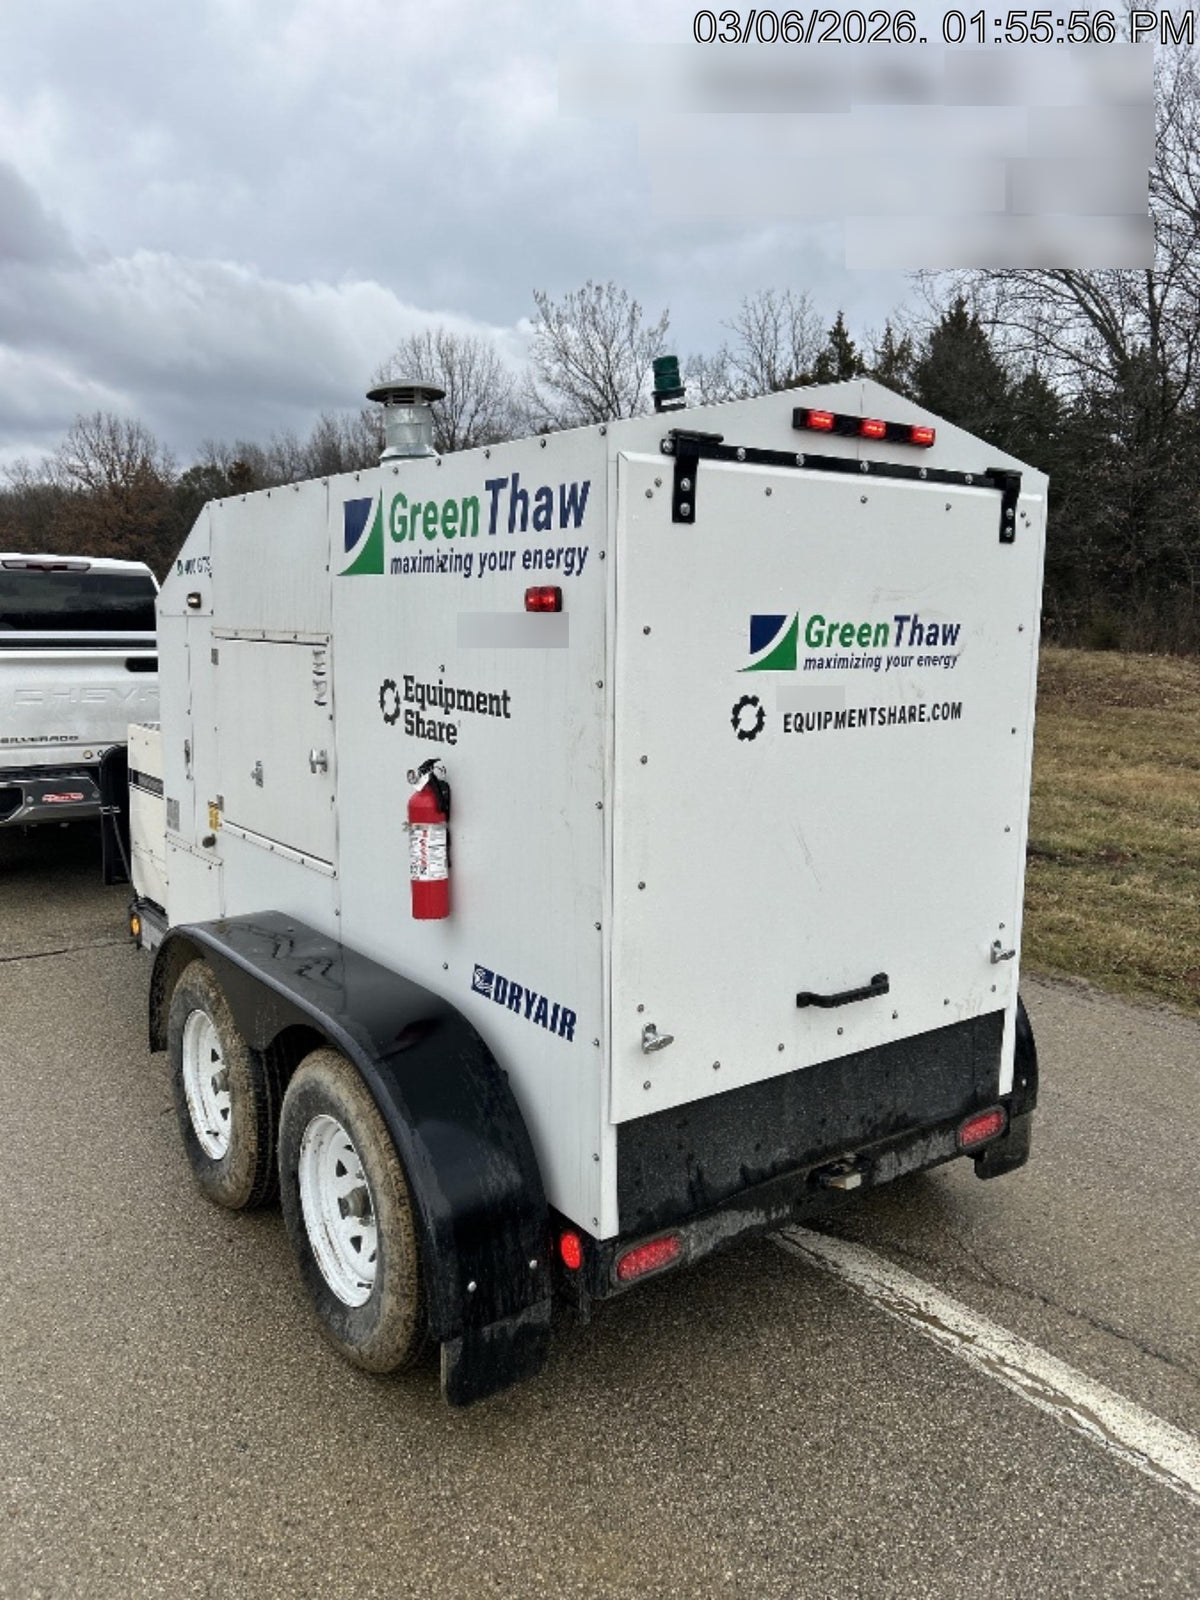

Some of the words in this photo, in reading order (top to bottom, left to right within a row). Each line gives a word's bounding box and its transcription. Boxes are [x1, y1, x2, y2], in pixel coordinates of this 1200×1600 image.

[390, 548, 473, 578] maximizing
[477, 550, 517, 579] your
[522, 546, 590, 577] energy
[803, 653, 882, 673] maximizing
[884, 655, 915, 673] your
[917, 653, 959, 670] energy
[403, 675, 512, 719] Equipment
[404, 709, 459, 745] Share
[782, 701, 964, 735] EQUIPMENTSHARE.COM
[0, 735, 79, 744] SILVERADO
[493, 973, 577, 1043] DRYAIR
